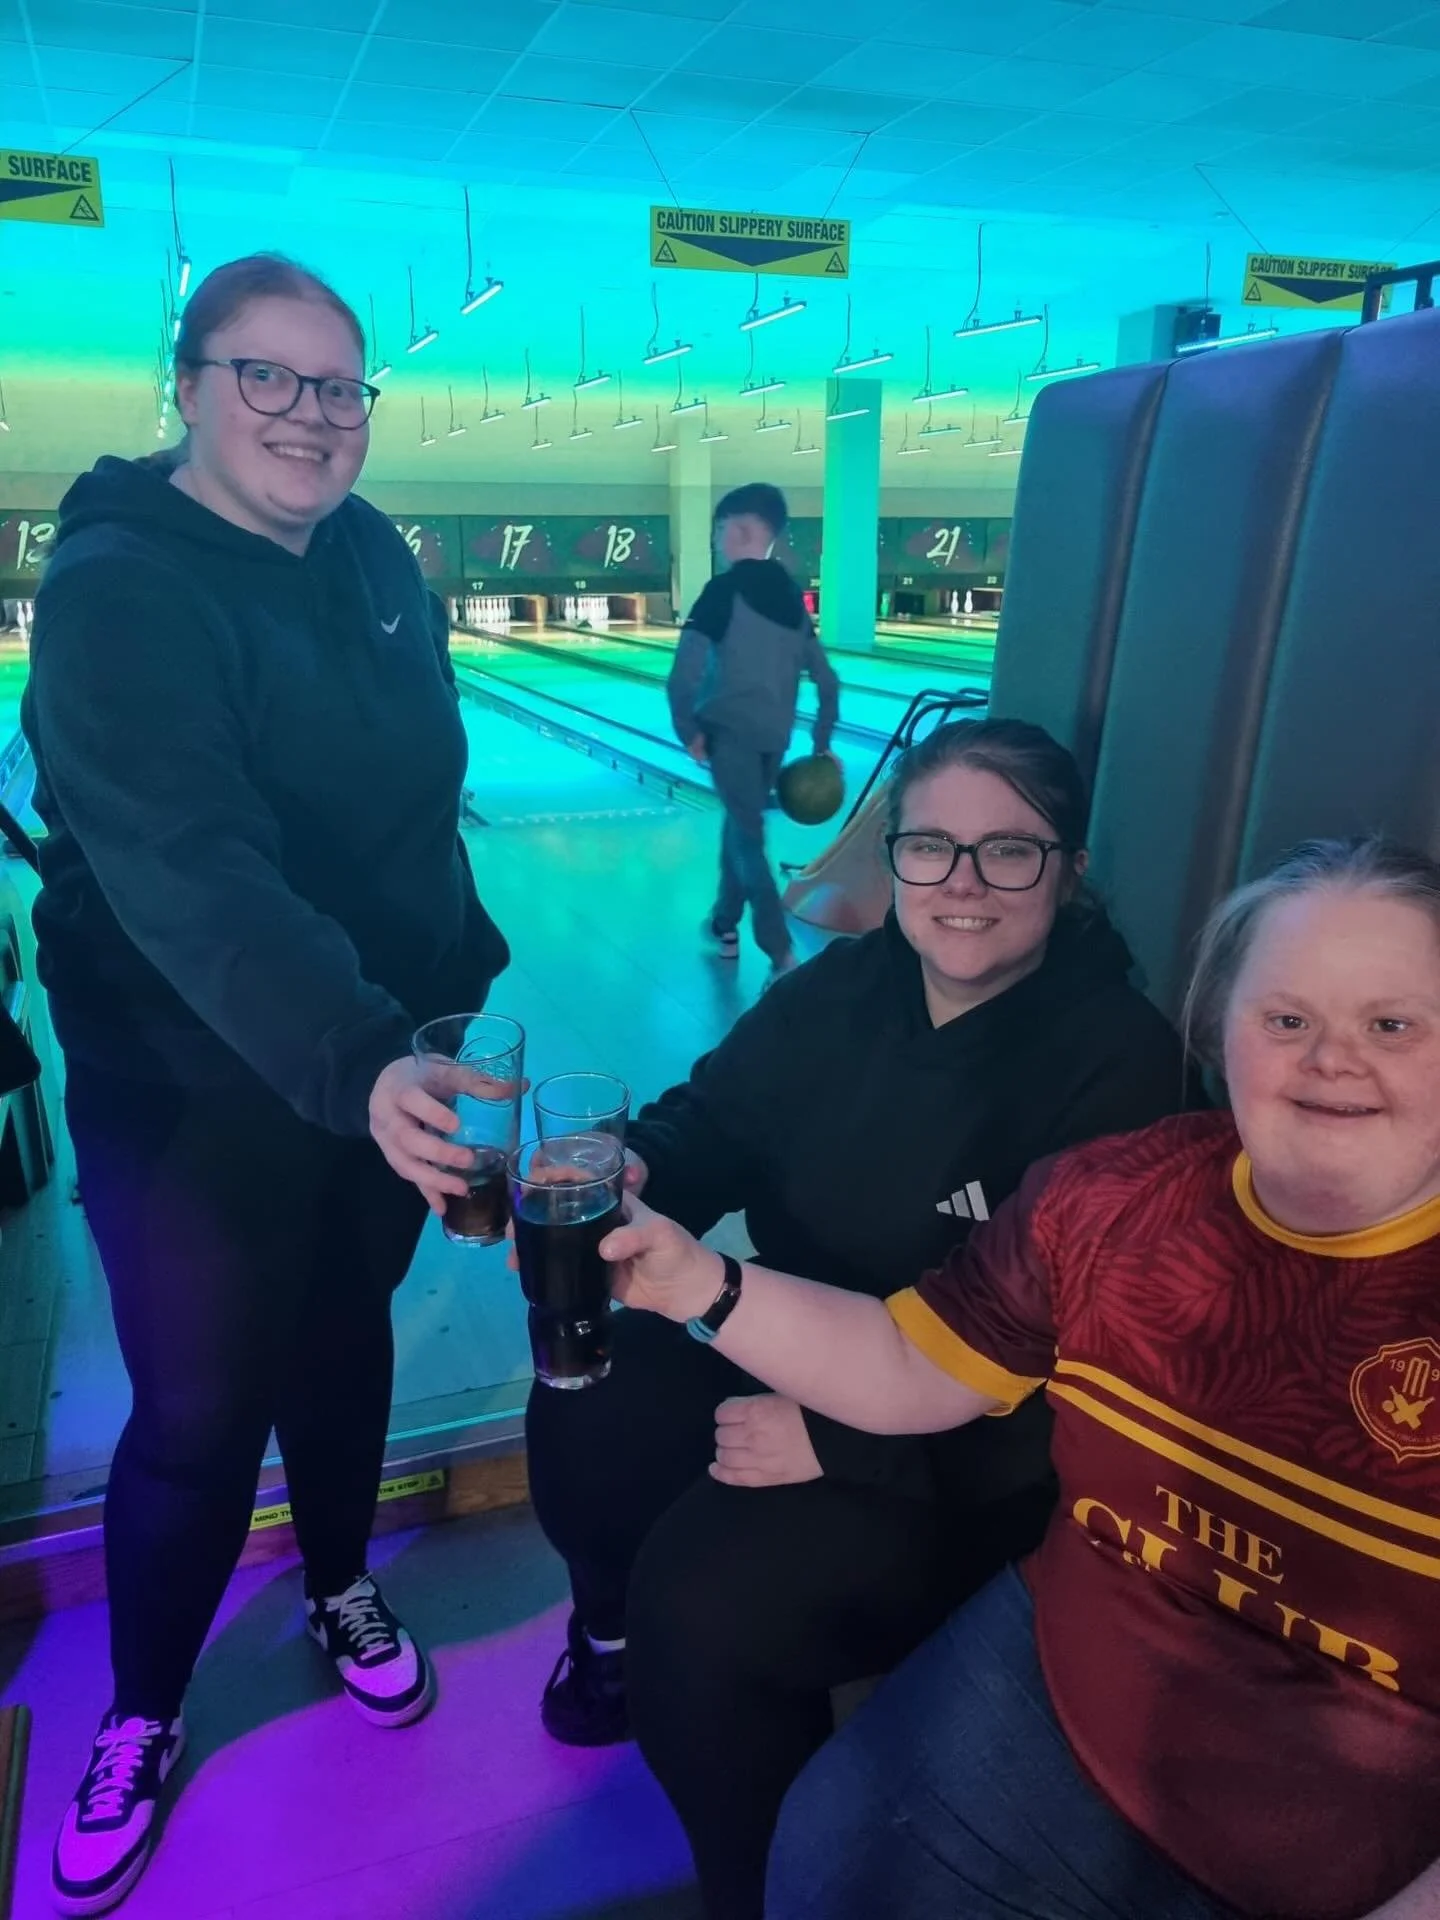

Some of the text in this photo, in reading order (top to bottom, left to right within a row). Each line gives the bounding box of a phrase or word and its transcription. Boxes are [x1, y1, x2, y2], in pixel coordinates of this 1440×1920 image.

[8, 154, 92, 183] SURFACE
[656, 210, 846, 242] CAUTION SLIPPERY SURFACE
[1250, 256, 1295, 275] CAUTION
[1297, 260, 1346, 279] SLIPPERY
[395, 524, 422, 557] 6
[500, 524, 534, 571] 17
[603, 524, 636, 569] 18
[926, 525, 962, 567] 21
[472, 581, 485, 591] 17
[1389, 1357, 1406, 1373] 19
[254, 1511, 279, 1523] MIND
[1155, 1484, 1285, 1585] THE
